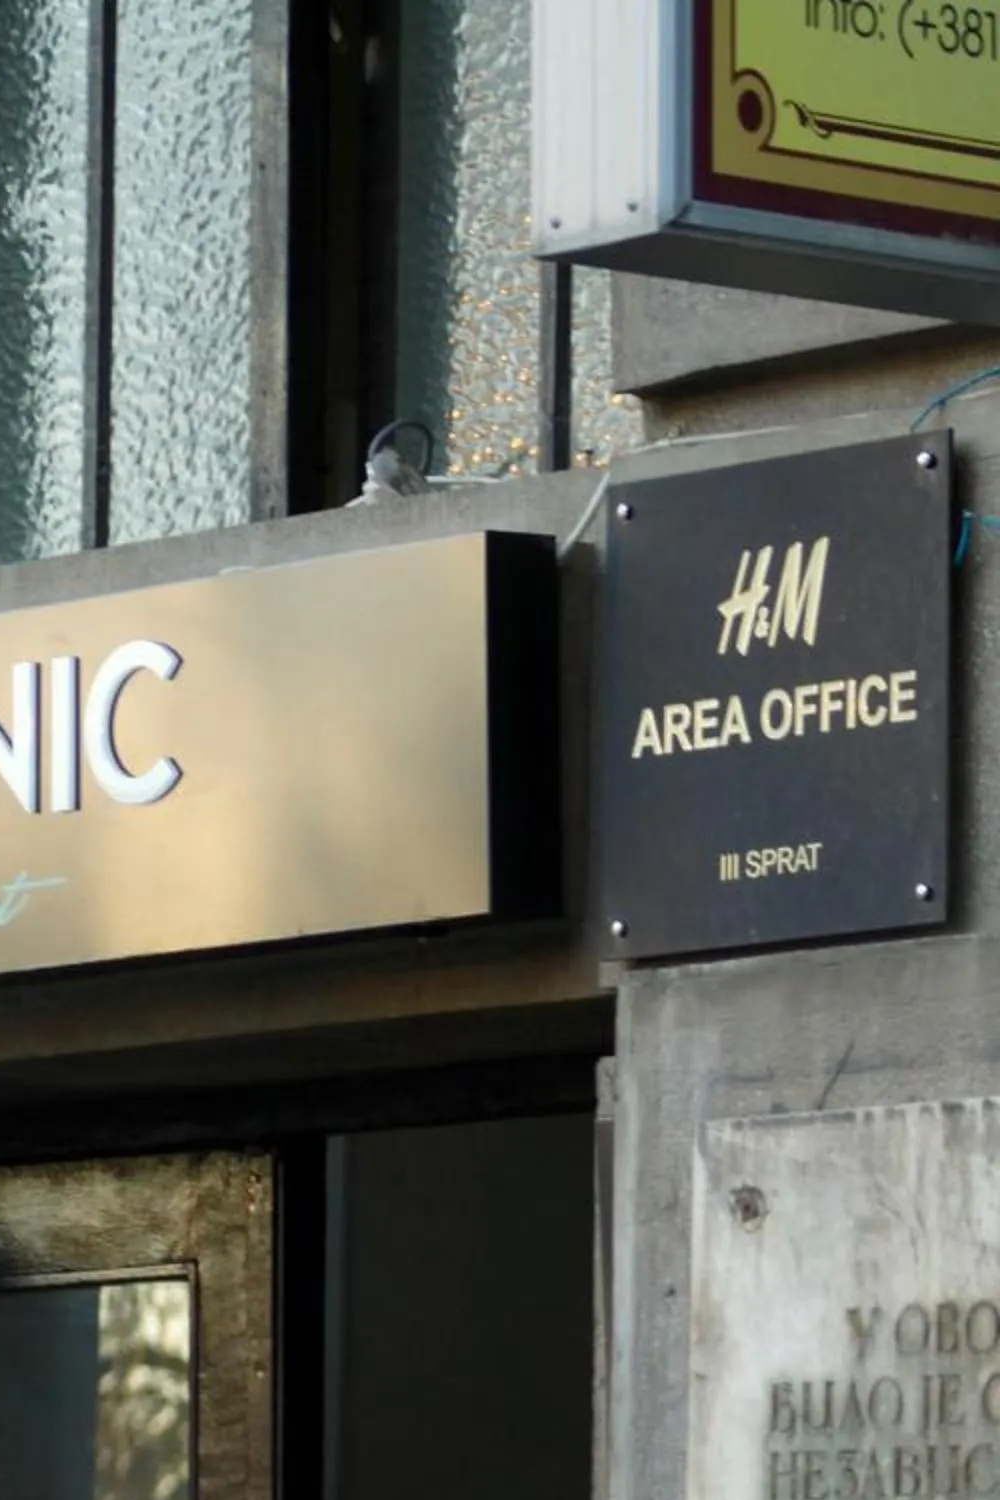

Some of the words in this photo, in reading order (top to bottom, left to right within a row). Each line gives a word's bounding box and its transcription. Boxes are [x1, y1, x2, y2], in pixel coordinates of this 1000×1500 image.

[717, 536, 830, 656] H&M
[631, 695, 752, 759] AREA
[760, 670, 918, 741] OFFICE
[744, 842, 823, 880] SPRAT
